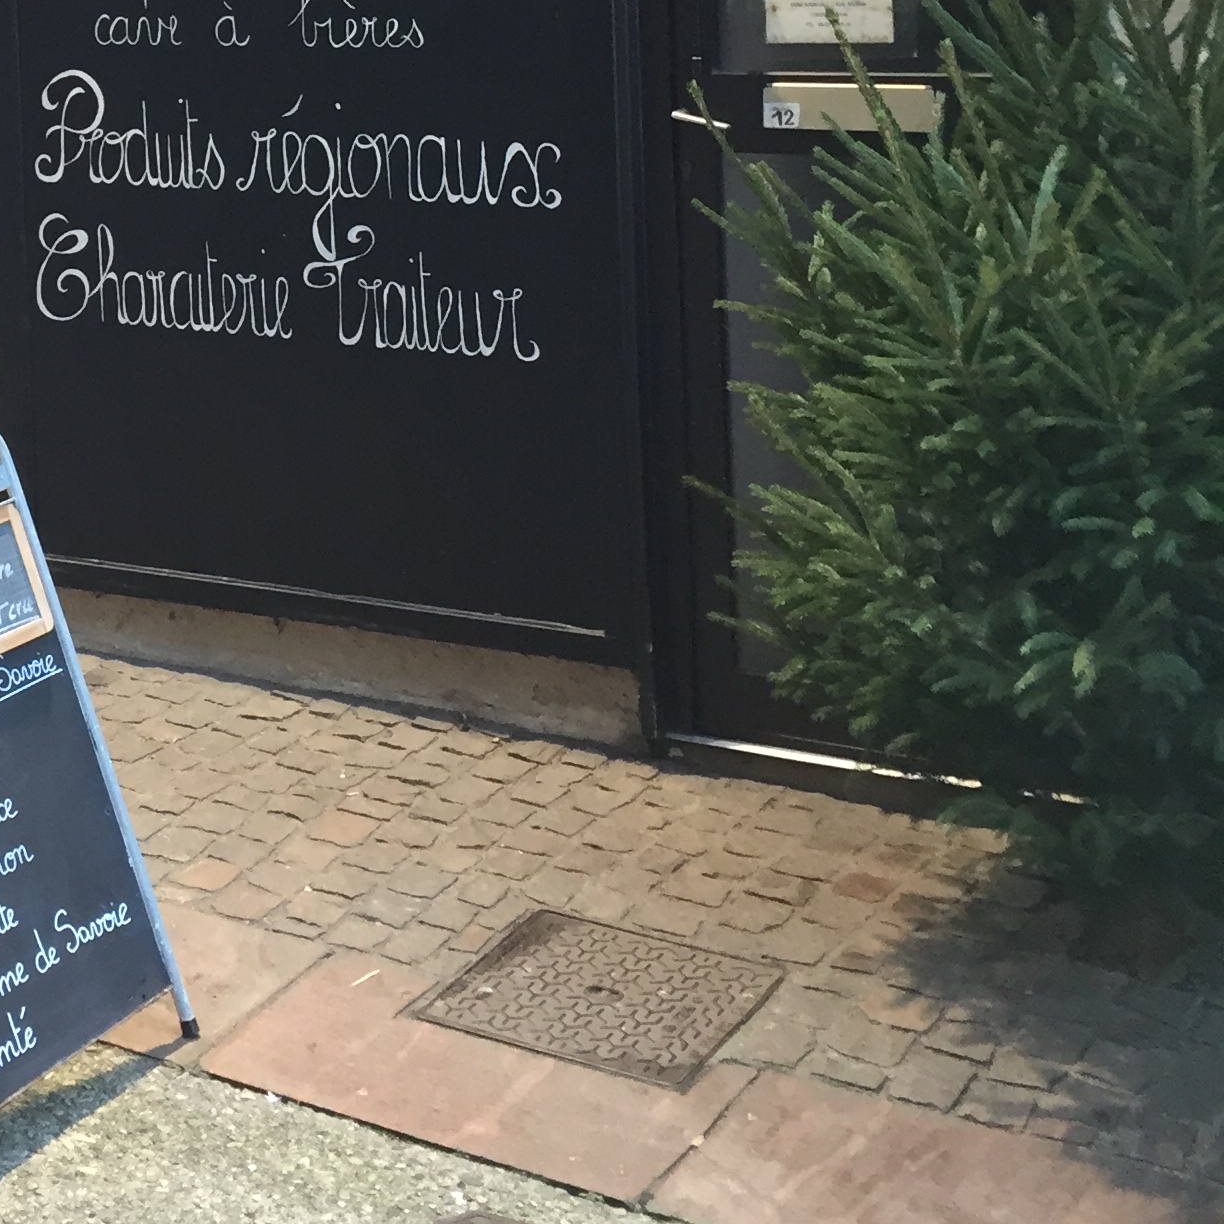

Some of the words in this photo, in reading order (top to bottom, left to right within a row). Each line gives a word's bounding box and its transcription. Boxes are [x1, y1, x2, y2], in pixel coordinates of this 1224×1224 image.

[94, 13, 182, 46] cave
[215, 1, 250, 47] à
[771, 108, 795, 127] 12
[35, 69, 226, 190] Produits
[236, 94, 562, 261] régionaux
[36, 213, 293, 339] Charcuterie
[303, 224, 540, 362] Traiteur
[34, 929, 60, 974] de
[54, 902, 132, 953] Savoie
